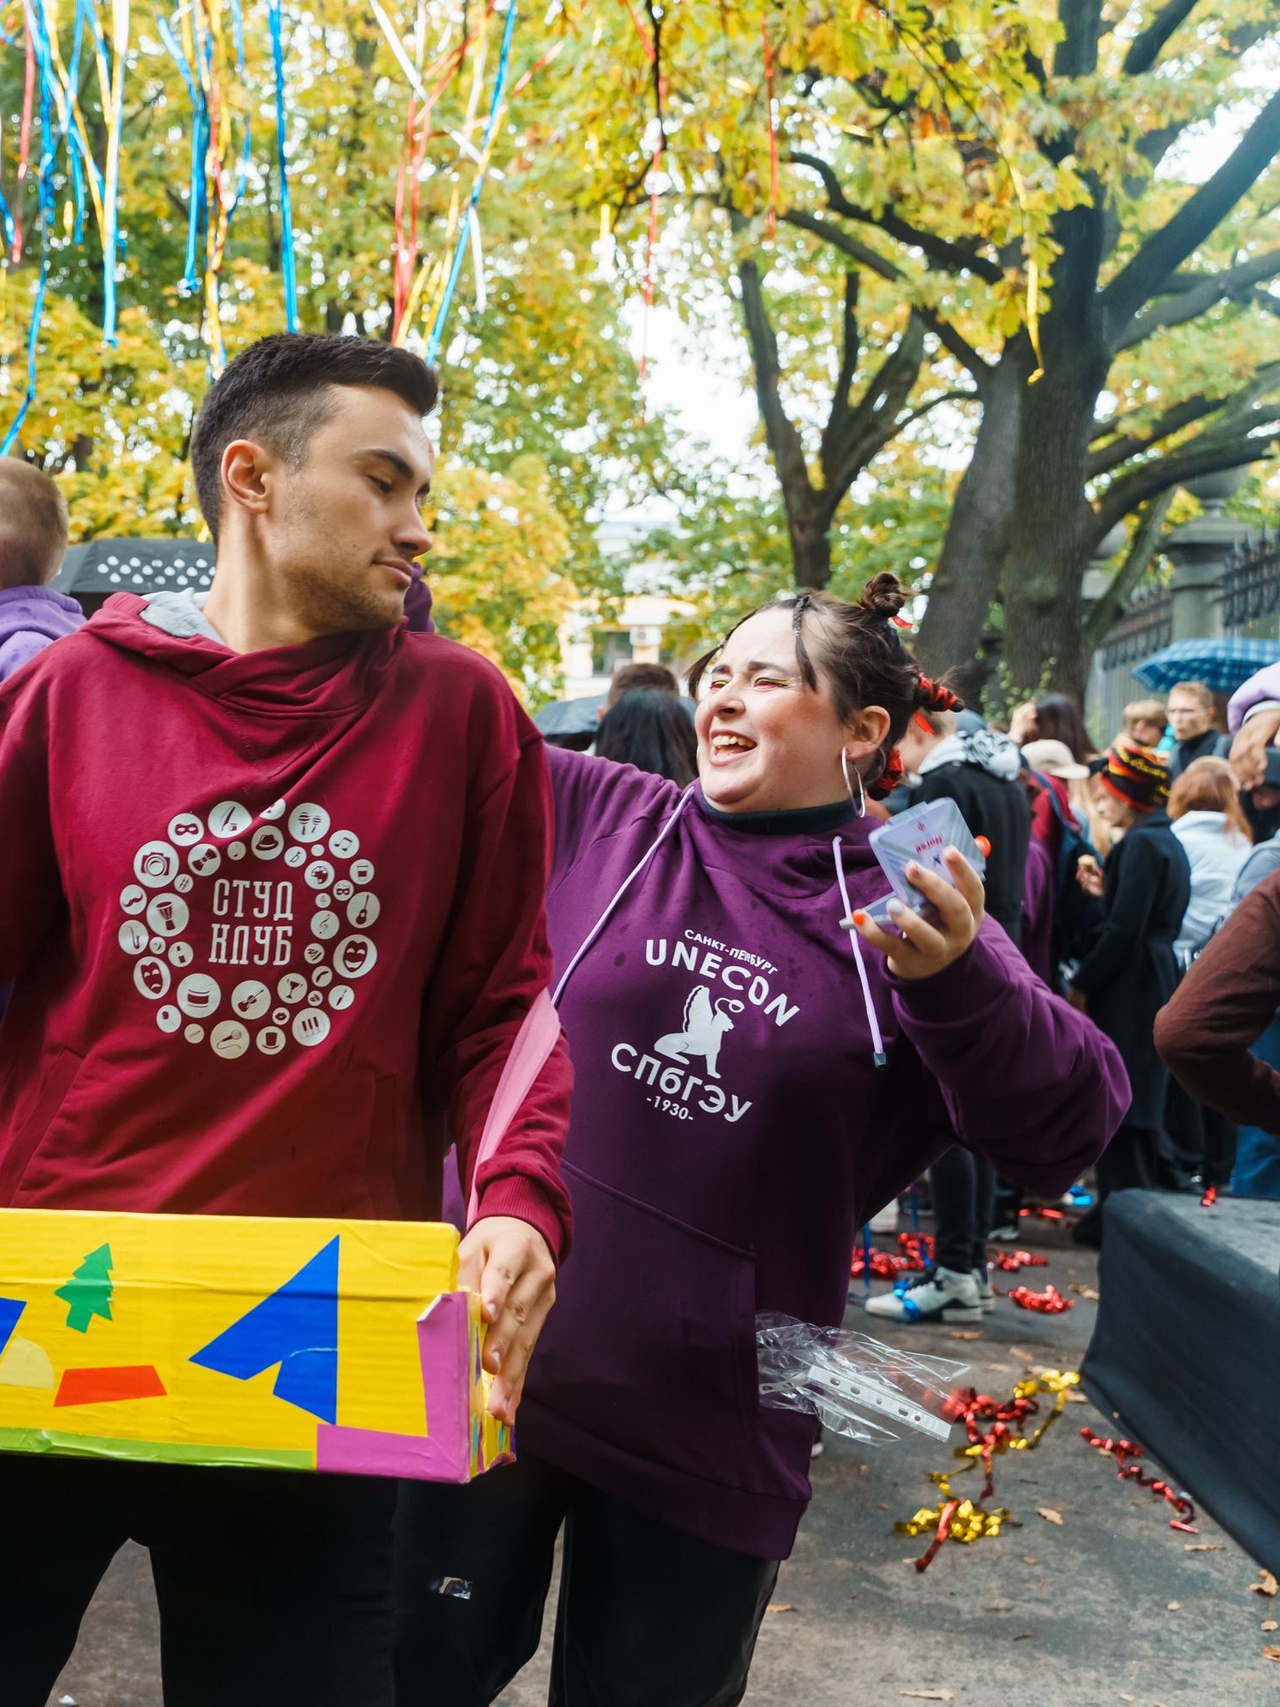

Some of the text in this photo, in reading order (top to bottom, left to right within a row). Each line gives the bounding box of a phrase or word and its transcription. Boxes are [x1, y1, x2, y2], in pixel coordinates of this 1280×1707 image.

[212, 878, 294, 921] СТУД
[208, 923, 294, 966] КЛУБ
[645, 938, 800, 1027] UNECON
